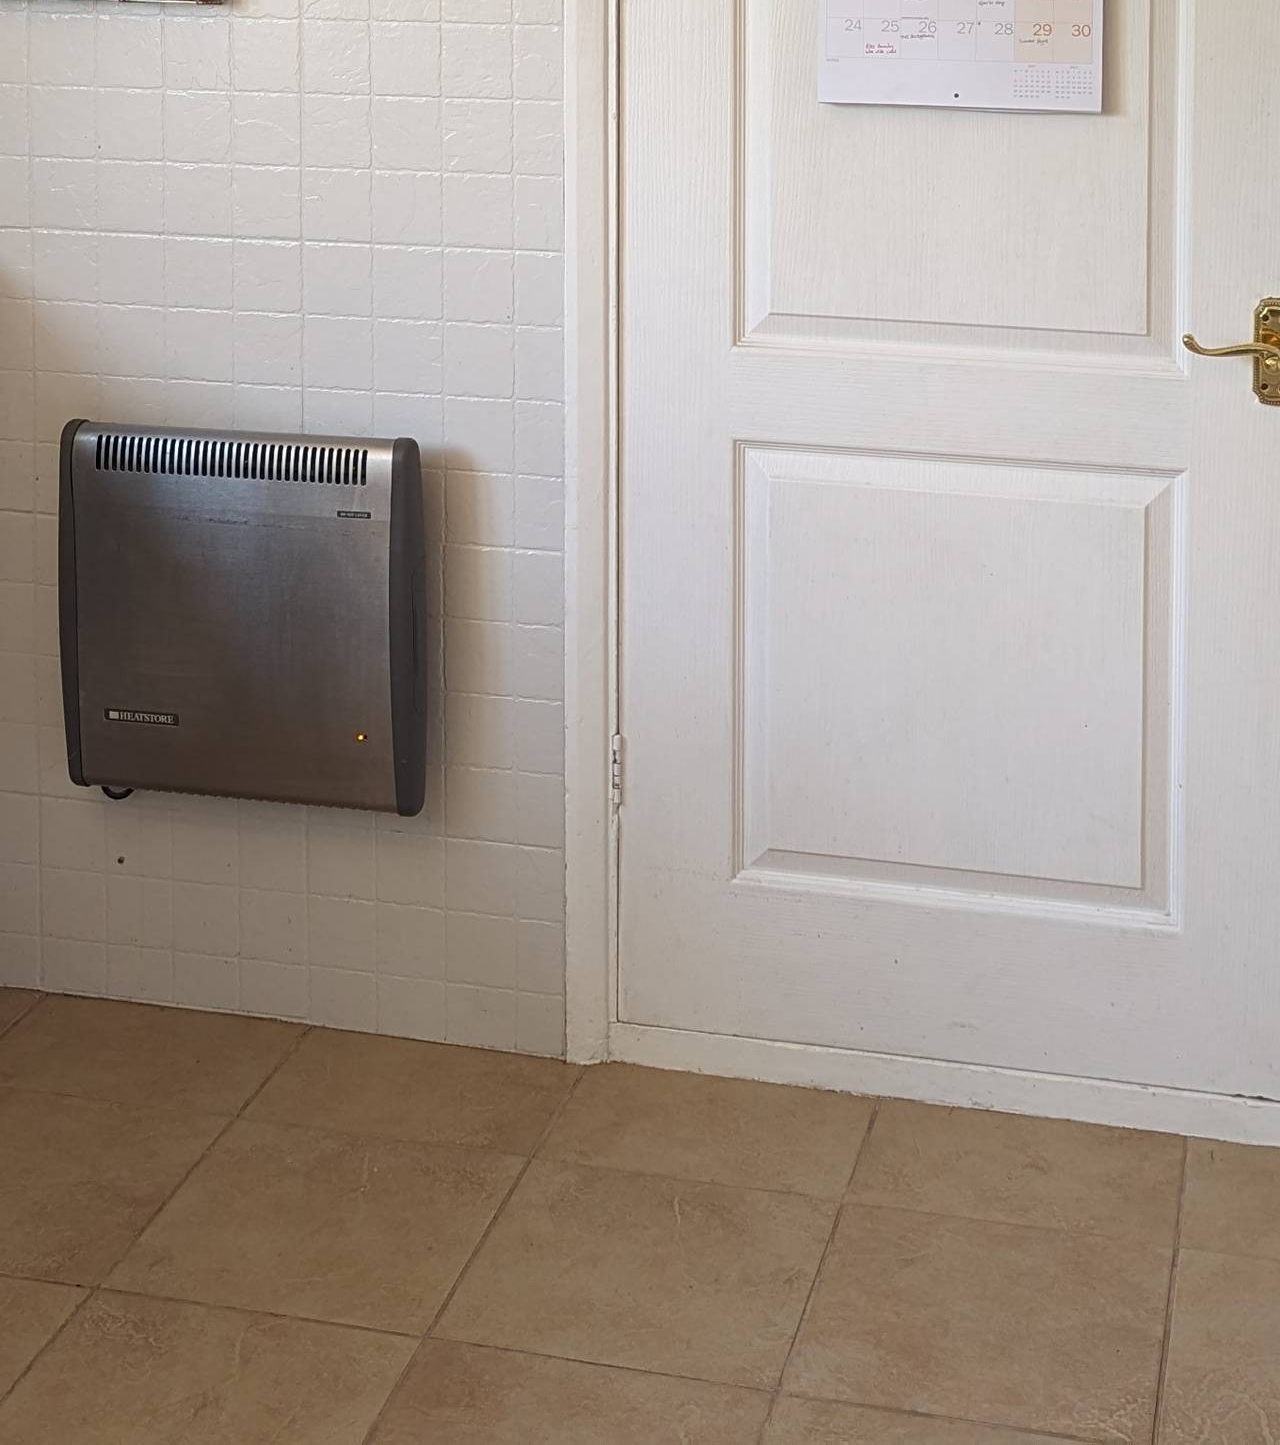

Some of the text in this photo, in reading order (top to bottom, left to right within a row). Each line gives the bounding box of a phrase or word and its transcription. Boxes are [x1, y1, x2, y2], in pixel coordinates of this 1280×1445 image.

[844, 19, 1091, 37] 24 25 26 27 28 29 30
[120, 712, 174, 724] HEATSTORE
